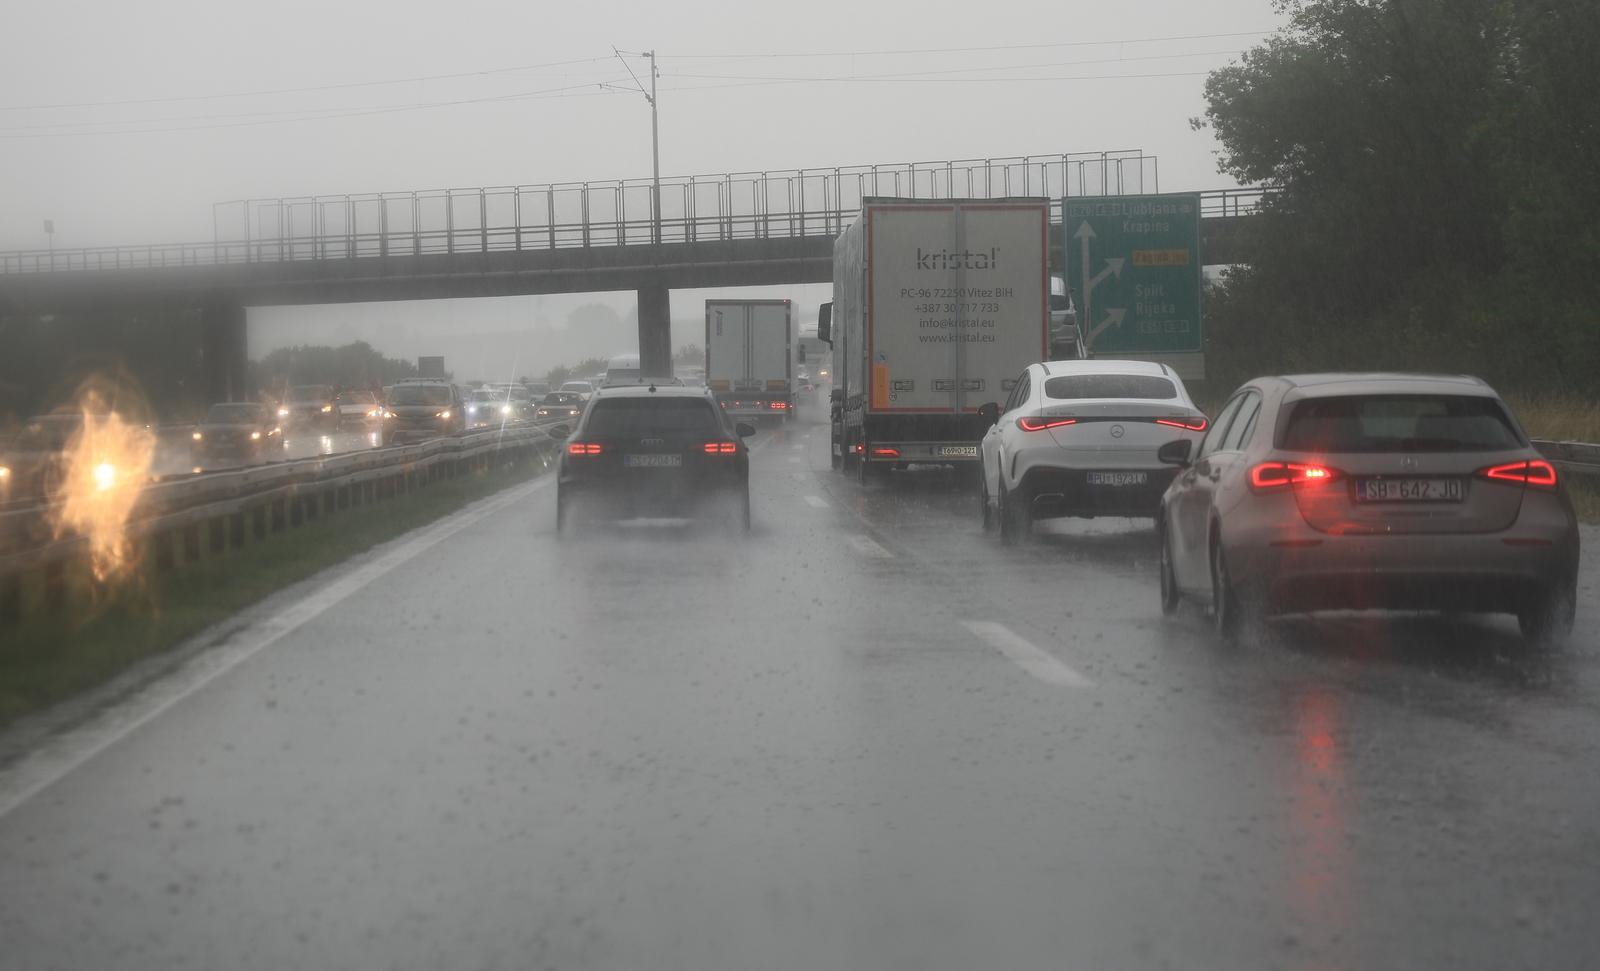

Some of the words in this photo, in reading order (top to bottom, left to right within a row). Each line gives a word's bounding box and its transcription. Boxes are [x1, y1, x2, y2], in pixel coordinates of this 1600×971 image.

[1122, 201, 1176, 218] Ljubljana
[1122, 220, 1169, 234] Krapina
[916, 247, 996, 270] kristal
[901, 288, 931, 298] PC-96
[934, 288, 966, 298] 72250
[968, 287, 993, 298] Vitez
[995, 287, 1013, 298] BiH
[1135, 283, 1164, 299] Split
[914, 303, 942, 313] +387
[943, 303, 957, 313] 30
[959, 303, 976, 313] 717
[981, 303, 999, 313] 733
[1135, 301, 1176, 317] Rijeka
[919, 318, 995, 328] info@kristal.eu
[919, 332, 995, 343] www.kristal.eu
